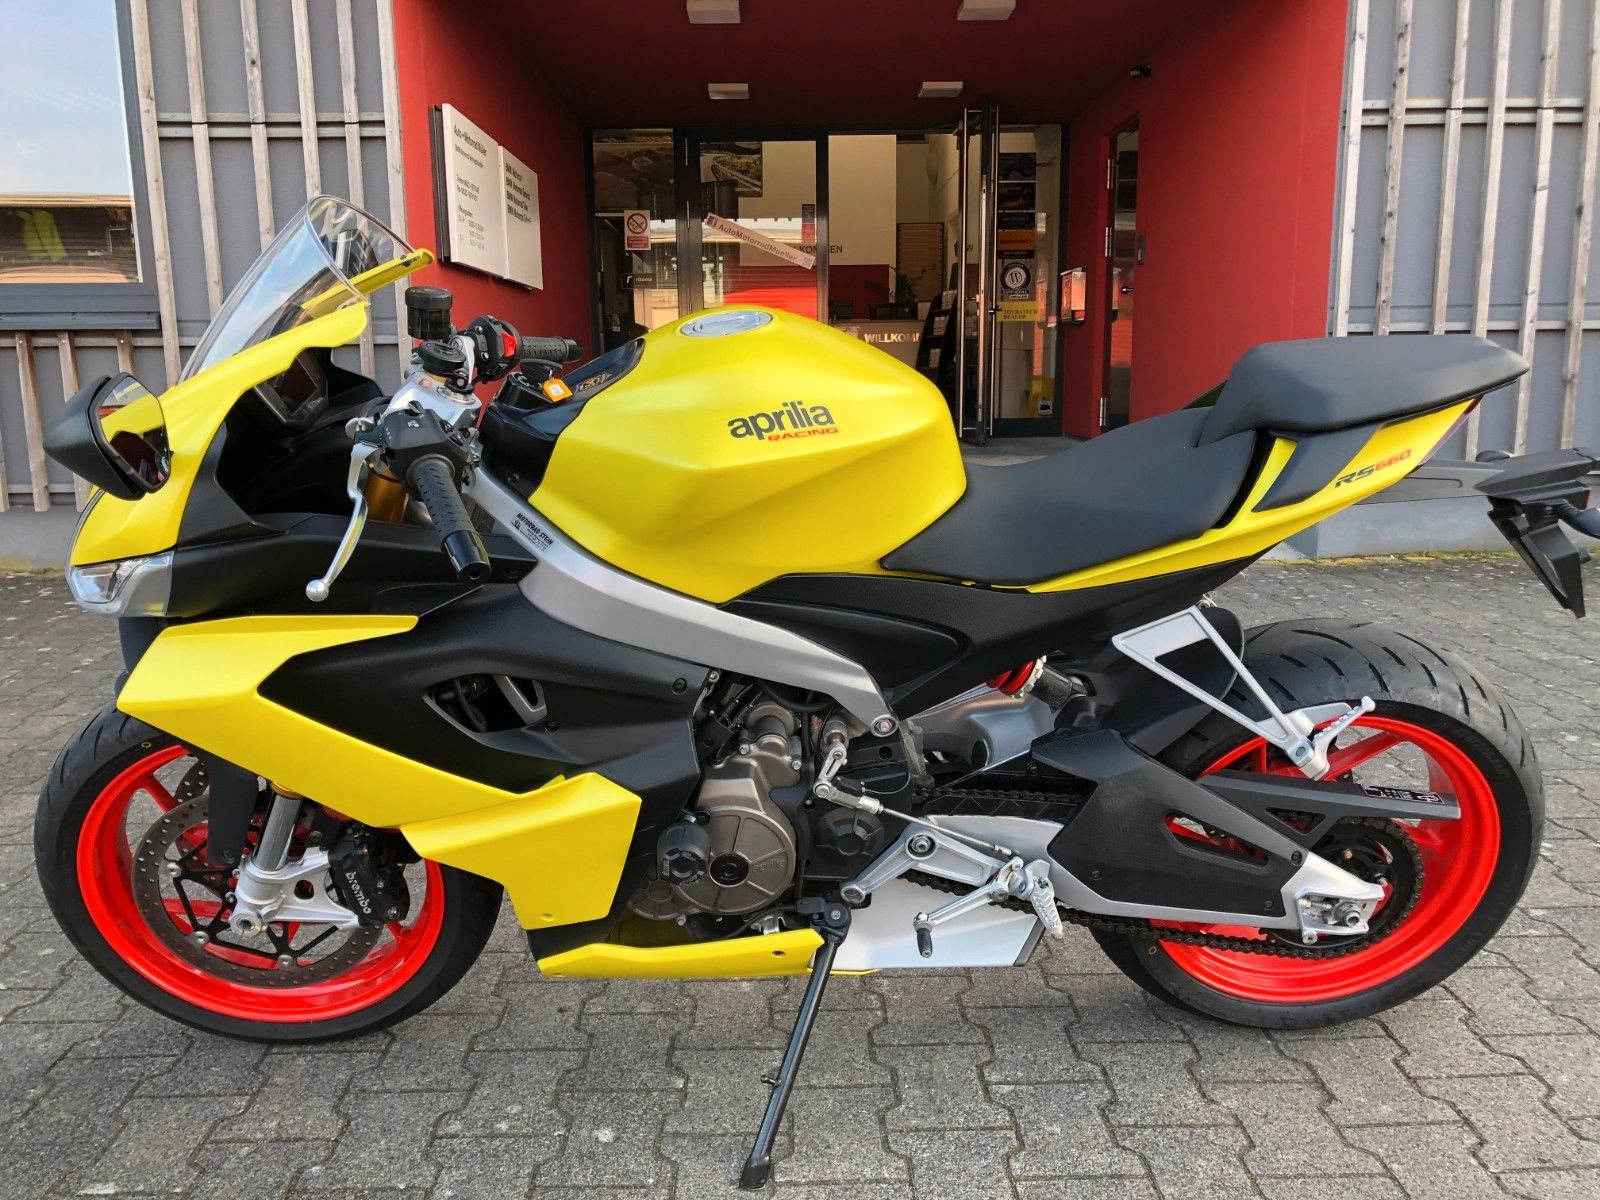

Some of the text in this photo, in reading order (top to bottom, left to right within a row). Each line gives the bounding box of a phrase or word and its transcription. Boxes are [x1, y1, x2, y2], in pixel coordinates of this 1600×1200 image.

[718, 224, 798, 262] AutoMotorradMueller
[727, 400, 836, 441] aprilia
[767, 427, 840, 442] RACING
[516, 512, 542, 535] MOTORRAD
[539, 532, 554, 546] STEIN
[345, 871, 373, 914] brembo
